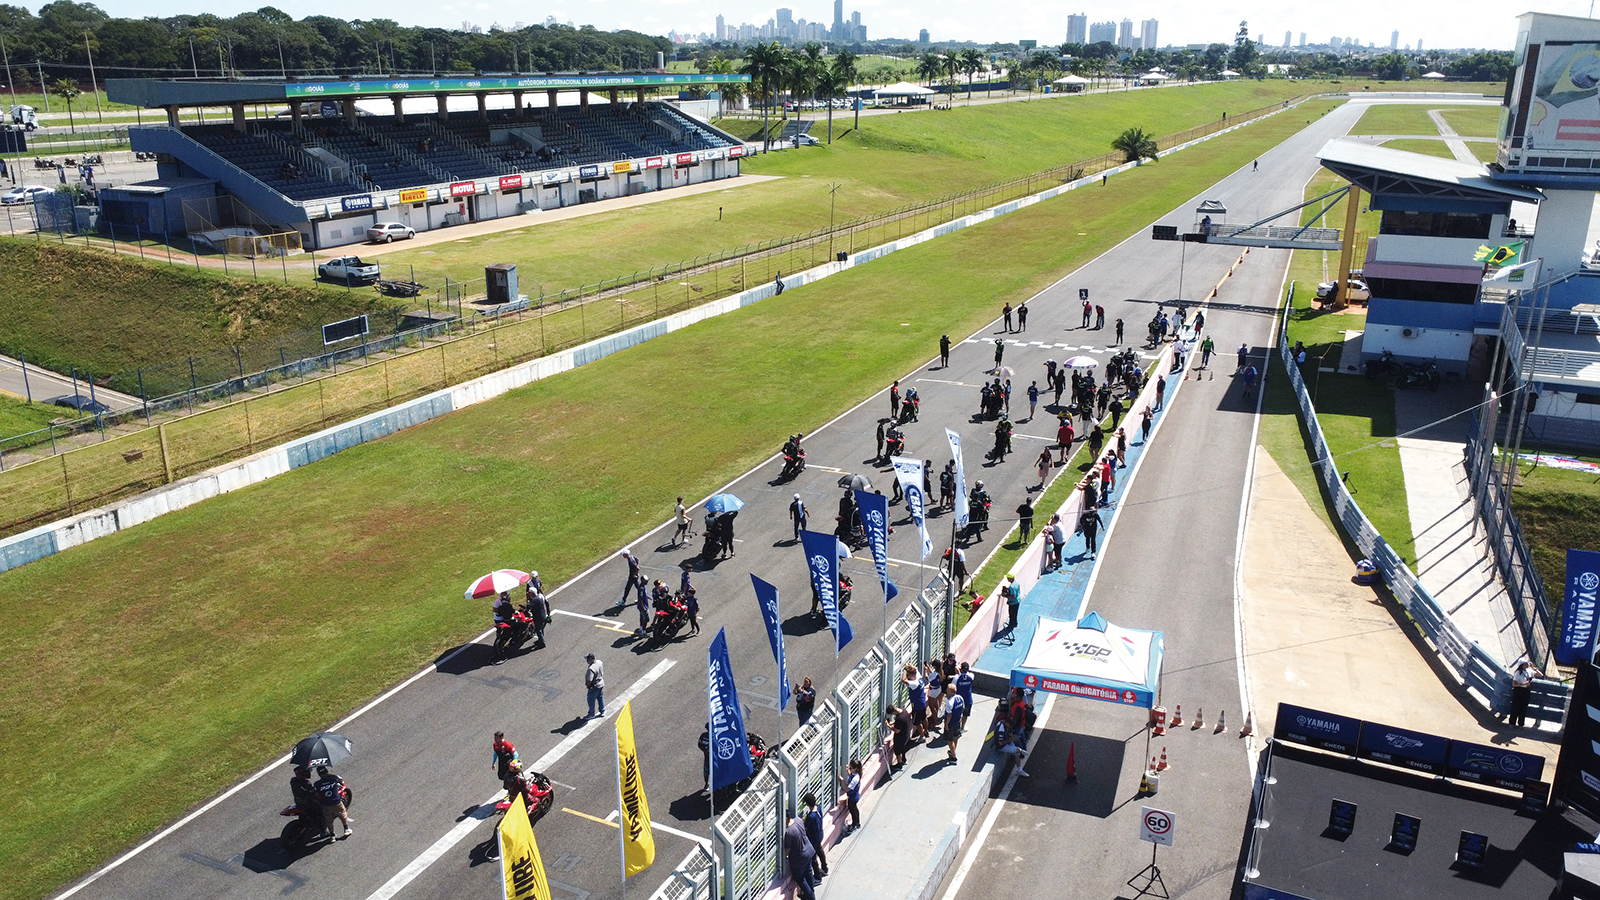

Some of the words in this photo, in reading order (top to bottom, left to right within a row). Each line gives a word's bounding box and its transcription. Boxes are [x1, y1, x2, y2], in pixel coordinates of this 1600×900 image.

[548, 78, 581, 86] INTERNACIONAL
[453, 184, 474, 194] MOTUL
[350, 197, 371, 206] YAMAHA
[402, 190, 426, 201] PIRELLI
[1572, 590, 1597, 649] YAMAHA
[1084, 644, 1112, 657] GP
[1043, 680, 1070, 692] PARADA
[1071, 685, 1117, 700] OBRIGATÓRIA
[709, 658, 729, 741] YAMAHA
[1306, 717, 1340, 732] YAMAHA
[1324, 742, 1346, 751] ENEOS
[1410, 761, 1433, 770] ENEOS
[1500, 780, 1525, 790] ENEOS
[623, 748, 643, 843] YAMALUBE
[1147, 816, 1168, 829] 60
